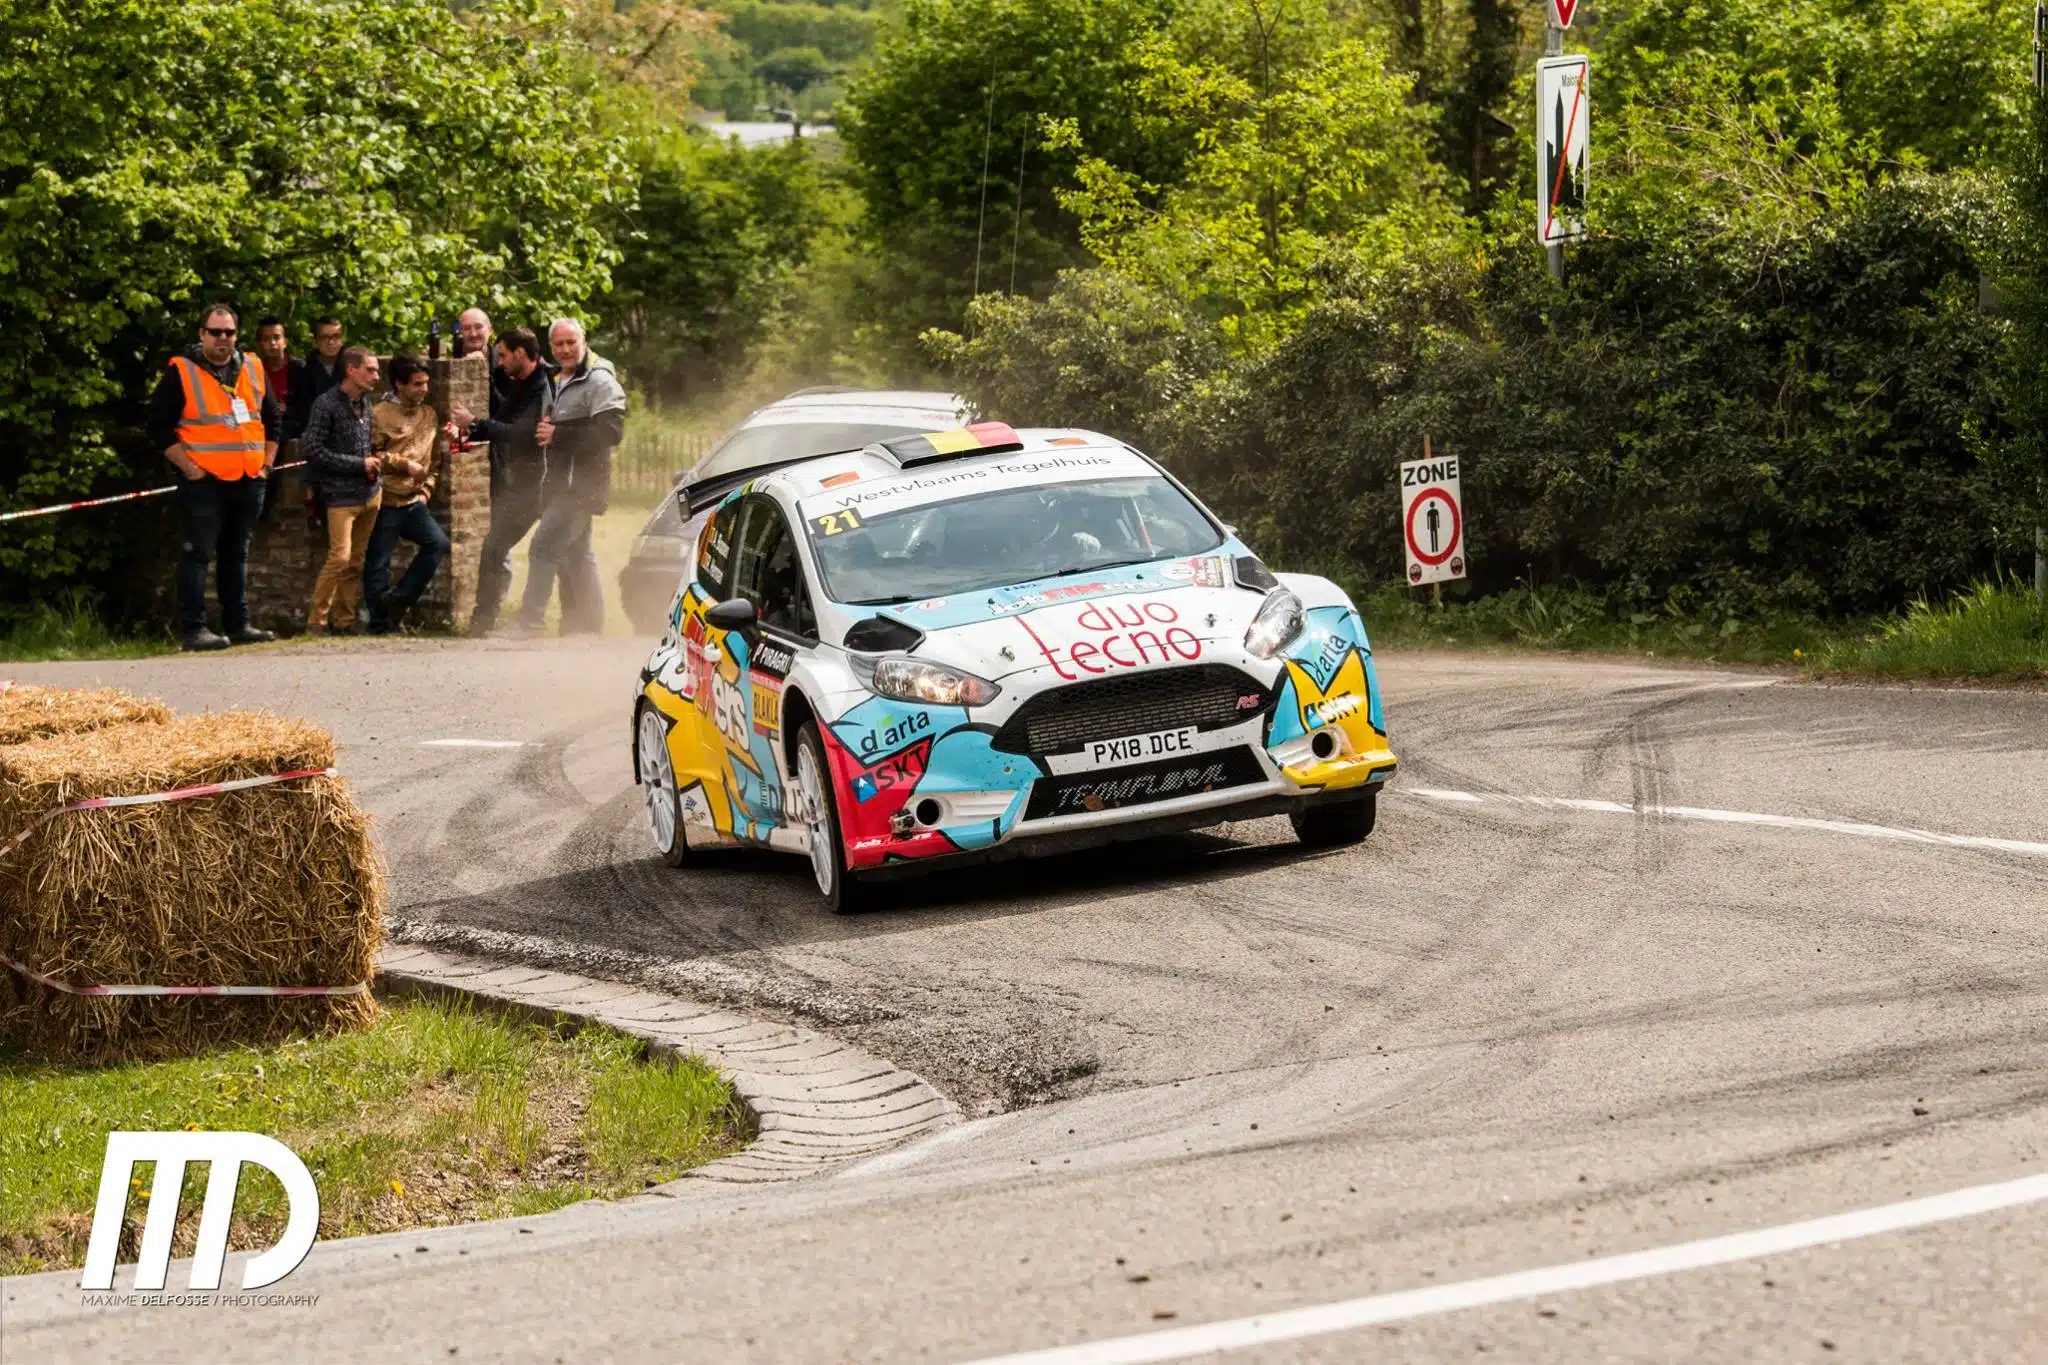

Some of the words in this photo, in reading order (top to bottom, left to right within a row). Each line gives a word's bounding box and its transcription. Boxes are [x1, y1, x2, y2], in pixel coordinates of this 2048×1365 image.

[836, 472, 988, 509] Westvlaams
[993, 456, 1112, 474] Tegelhuis
[1403, 460, 1458, 487] ZONE
[818, 509, 862, 537] 21
[1077, 600, 1178, 631] duo
[1014, 615, 1201, 680] tecno
[1236, 693, 1260, 710] RS
[875, 746, 926, 790] SKT
